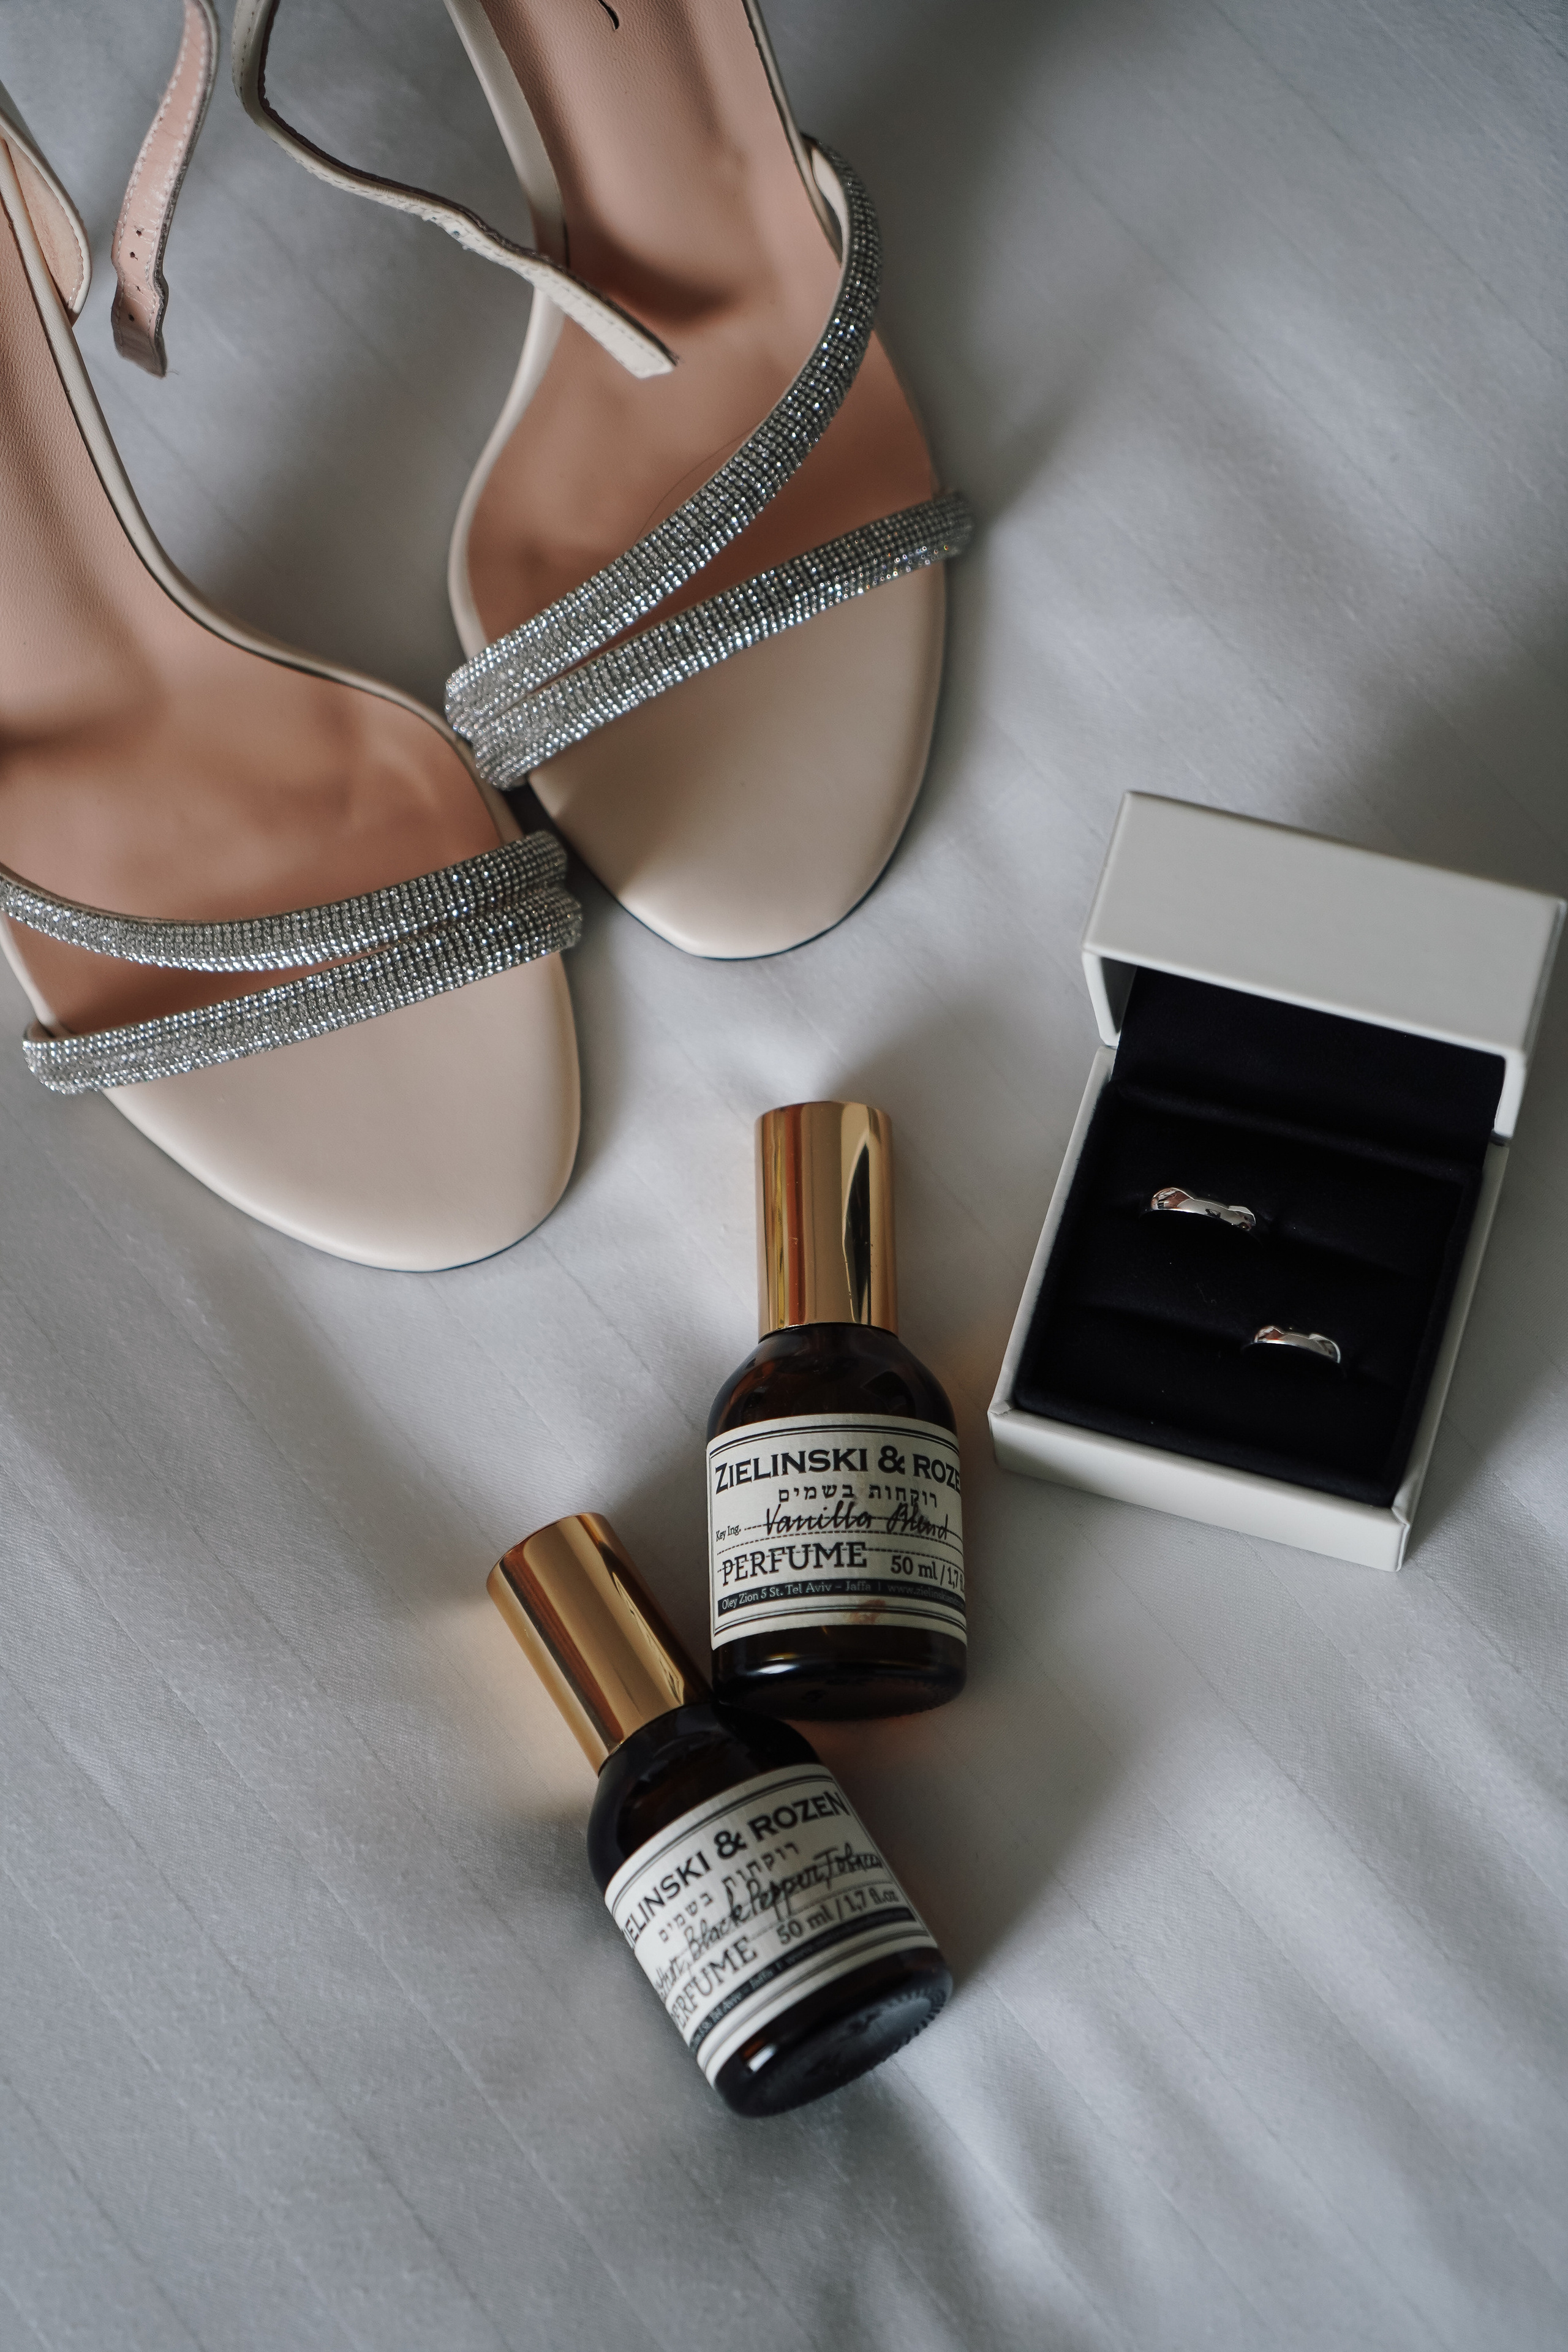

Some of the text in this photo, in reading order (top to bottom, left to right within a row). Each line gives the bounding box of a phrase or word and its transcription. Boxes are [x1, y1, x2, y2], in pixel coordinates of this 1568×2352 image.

[715, 1448, 869, 1495] ZIELINSKI
[878, 1445, 906, 1476] &
[778, 1483, 937, 1509] רוקחות בשמים
[715, 1529, 726, 1542] Key
[727, 1525, 742, 1537] Ing.
[766, 1500, 872, 1536] Vanilla
[722, 1542, 867, 1587] PERFUME
[890, 1554, 914, 1576] 50
[918, 1561, 938, 1581] ml
[722, 1597, 737, 1610] Oley
[739, 1592, 759, 1605] Zion
[760, 1586, 767, 1599] 5
[769, 1586, 783, 1598] St.
[785, 1583, 802, 1596] Tel
[805, 1582, 832, 1594] Aviv
[845, 1580, 872, 1591] Jaffa
[713, 1829, 748, 1860] &
[747, 1790, 851, 1843] ROZEN
[776, 1920, 804, 1946] 50
[807, 1904, 835, 1930] ml
